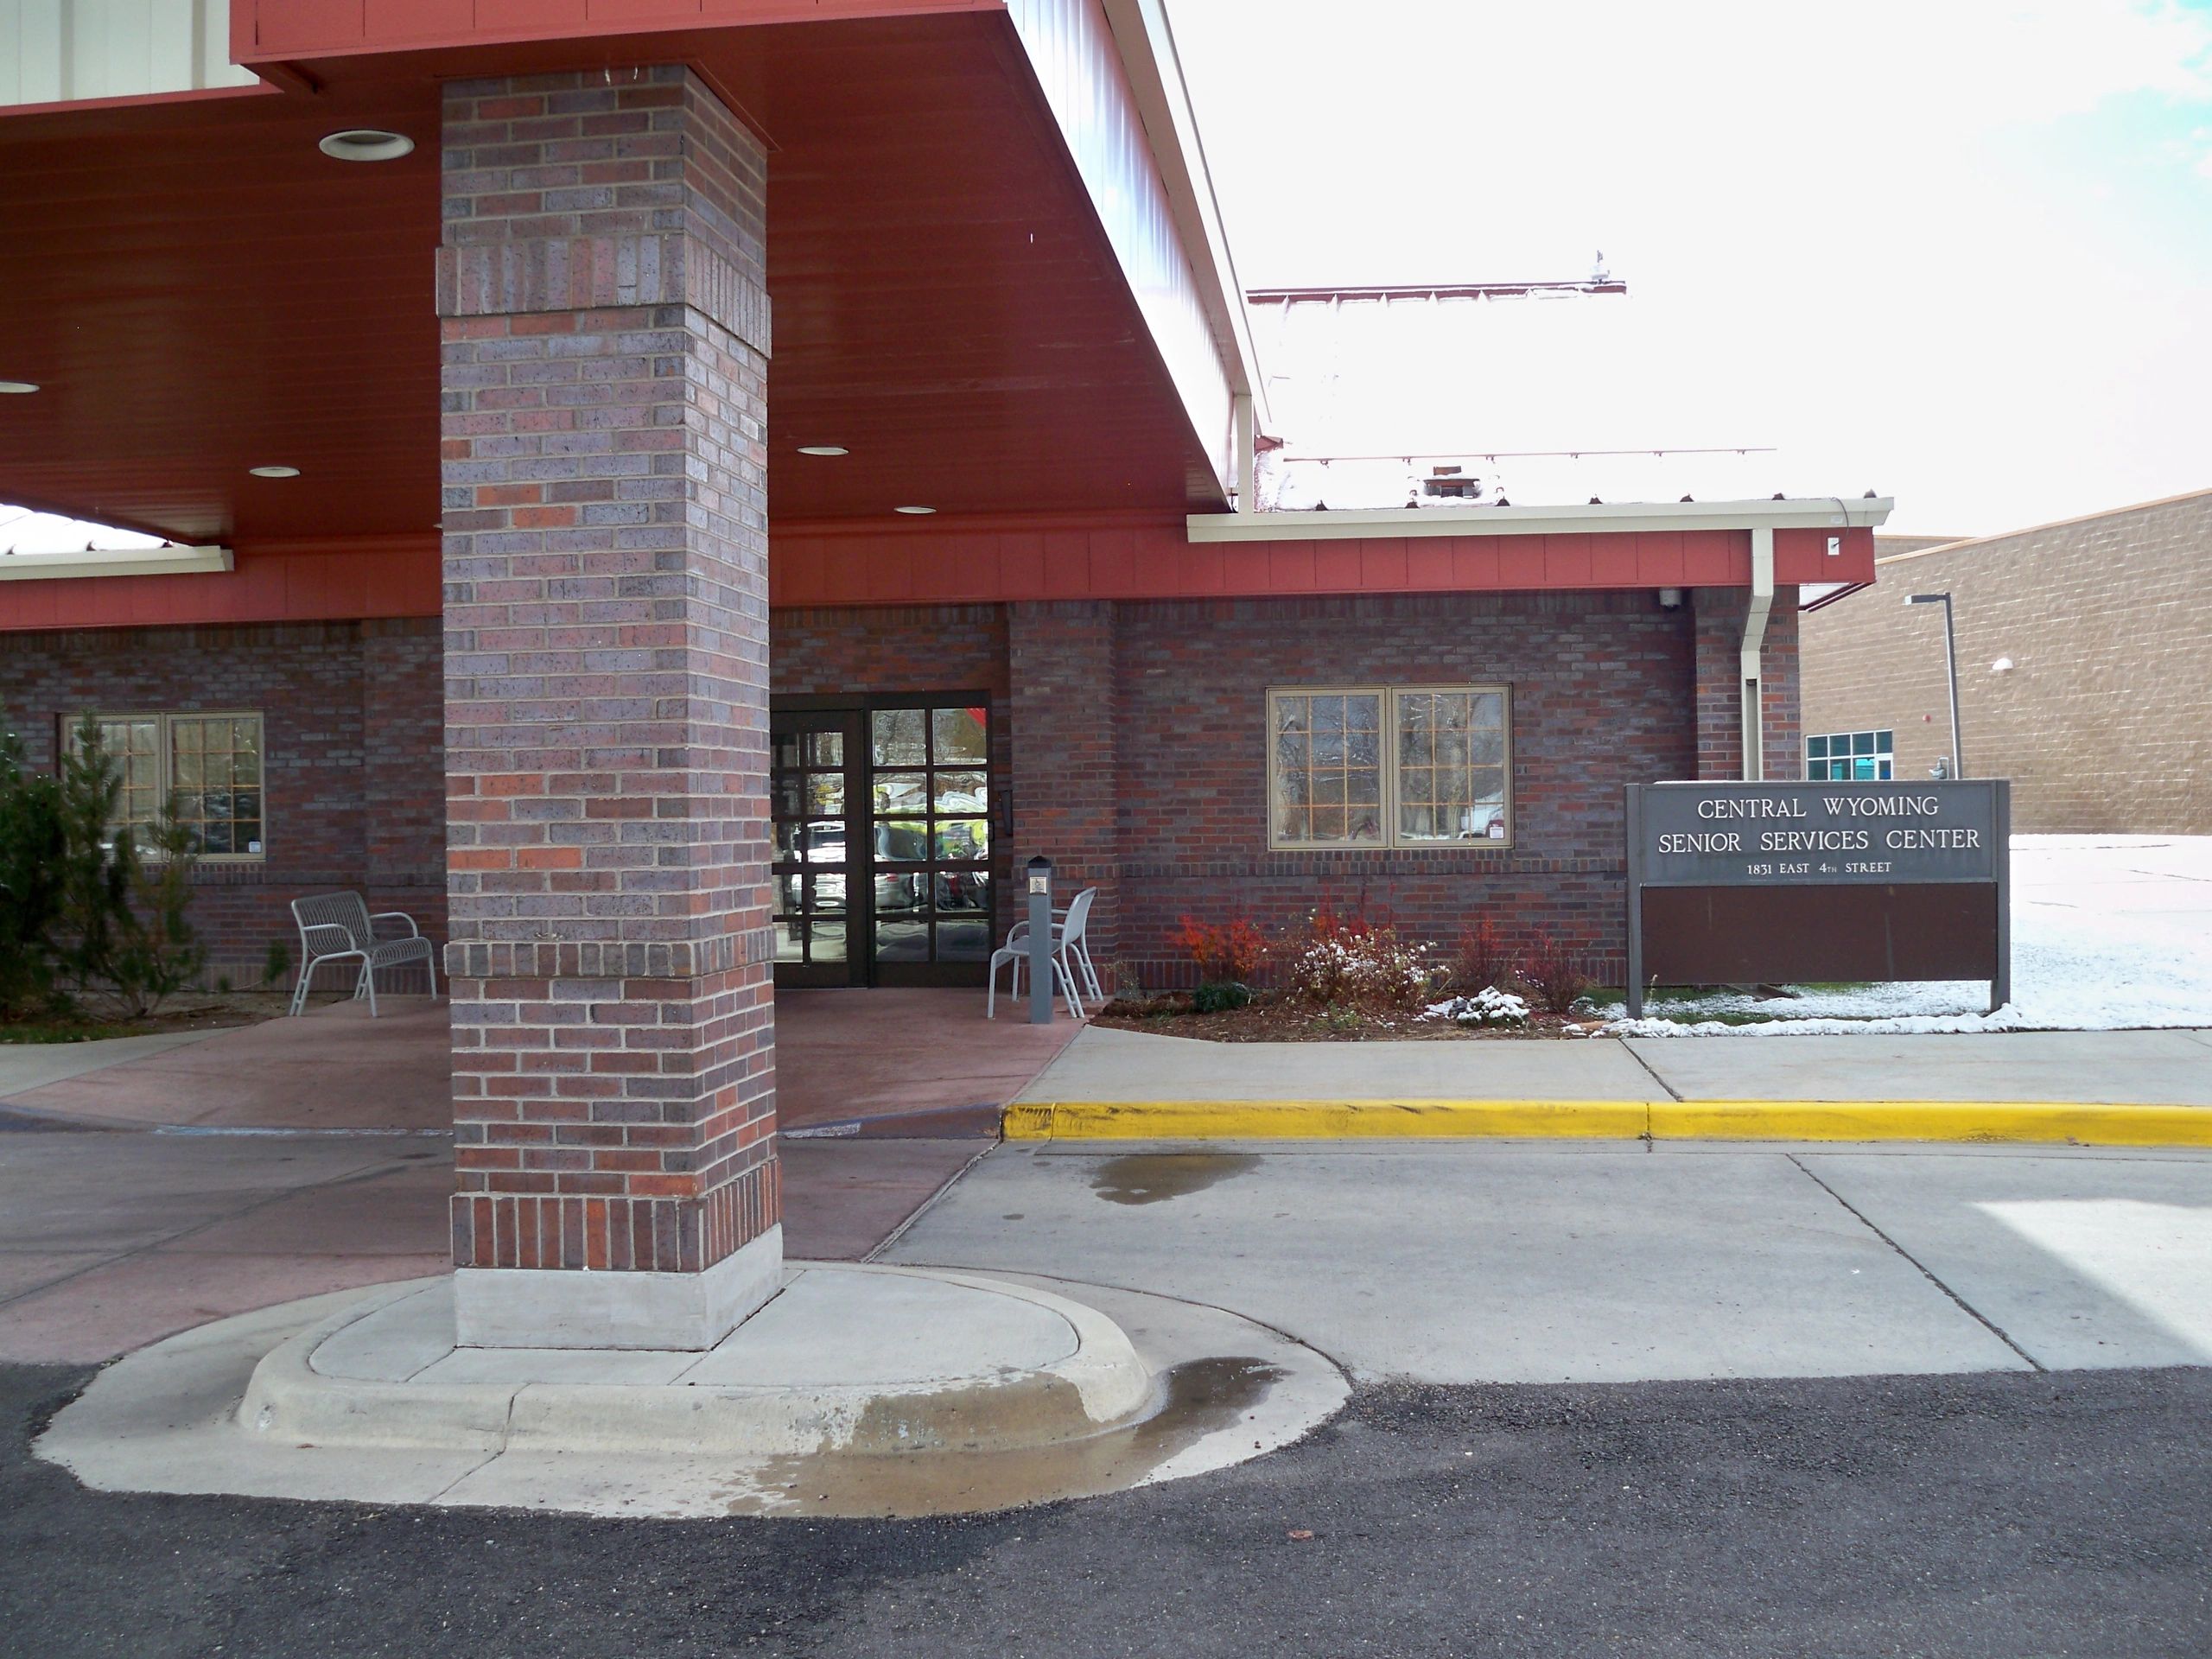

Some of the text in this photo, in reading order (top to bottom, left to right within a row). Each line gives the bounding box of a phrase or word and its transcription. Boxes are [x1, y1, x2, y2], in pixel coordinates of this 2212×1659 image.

[1698, 796, 1938, 819] CENTRAL WYOMING
[1658, 830, 1980, 854] SENIOR SERVICES CENTER
[1747, 864, 1772, 874] 1831
[1779, 863, 1809, 874] EAST
[1846, 862, 1892, 874] STREET
